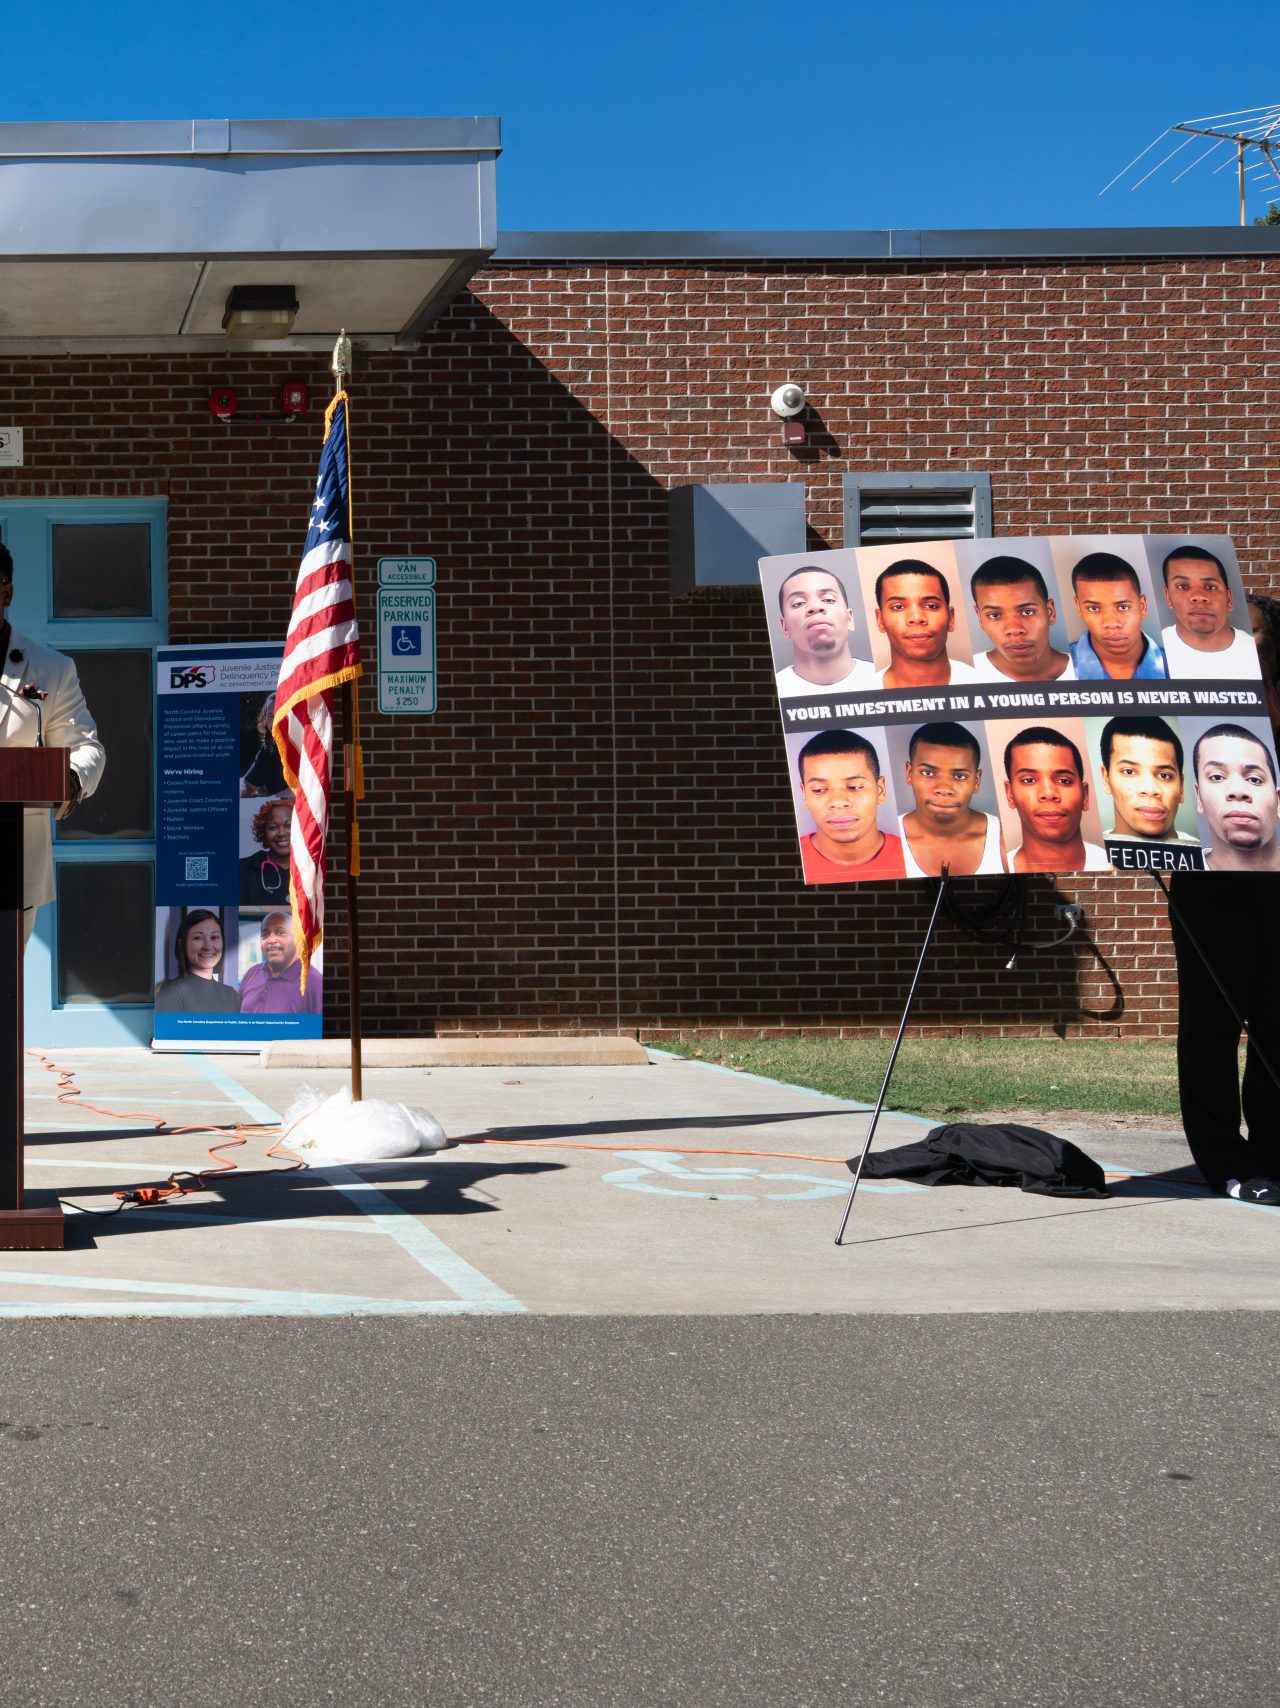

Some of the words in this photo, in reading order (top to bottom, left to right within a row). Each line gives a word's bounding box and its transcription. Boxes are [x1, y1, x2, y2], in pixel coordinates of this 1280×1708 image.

[397, 564, 417, 573] VAN
[381, 596, 431, 607] RESERVED
[383, 611, 429, 622] PARKING
[220, 663, 252, 672] Juvenile
[170, 673, 208, 689] DPS
[220, 672, 269, 681] Delinquency
[387, 675, 427, 684] MAXIMUM
[388, 686, 425, 695] PENALTY
[787, 706, 832, 721] YOUR
[835, 698, 946, 717] INVESTMENT
[949, 697, 970, 709] IN
[973, 696, 985, 708] A
[987, 693, 1045, 708] YOUNG
[1049, 692, 1115, 706] PERSON
[1117, 692, 1134, 705] IS
[1138, 691, 1191, 705] NEVER
[1192, 691, 1262, 705] WASTED.
[1109, 847, 1200, 871] FEDERAL
